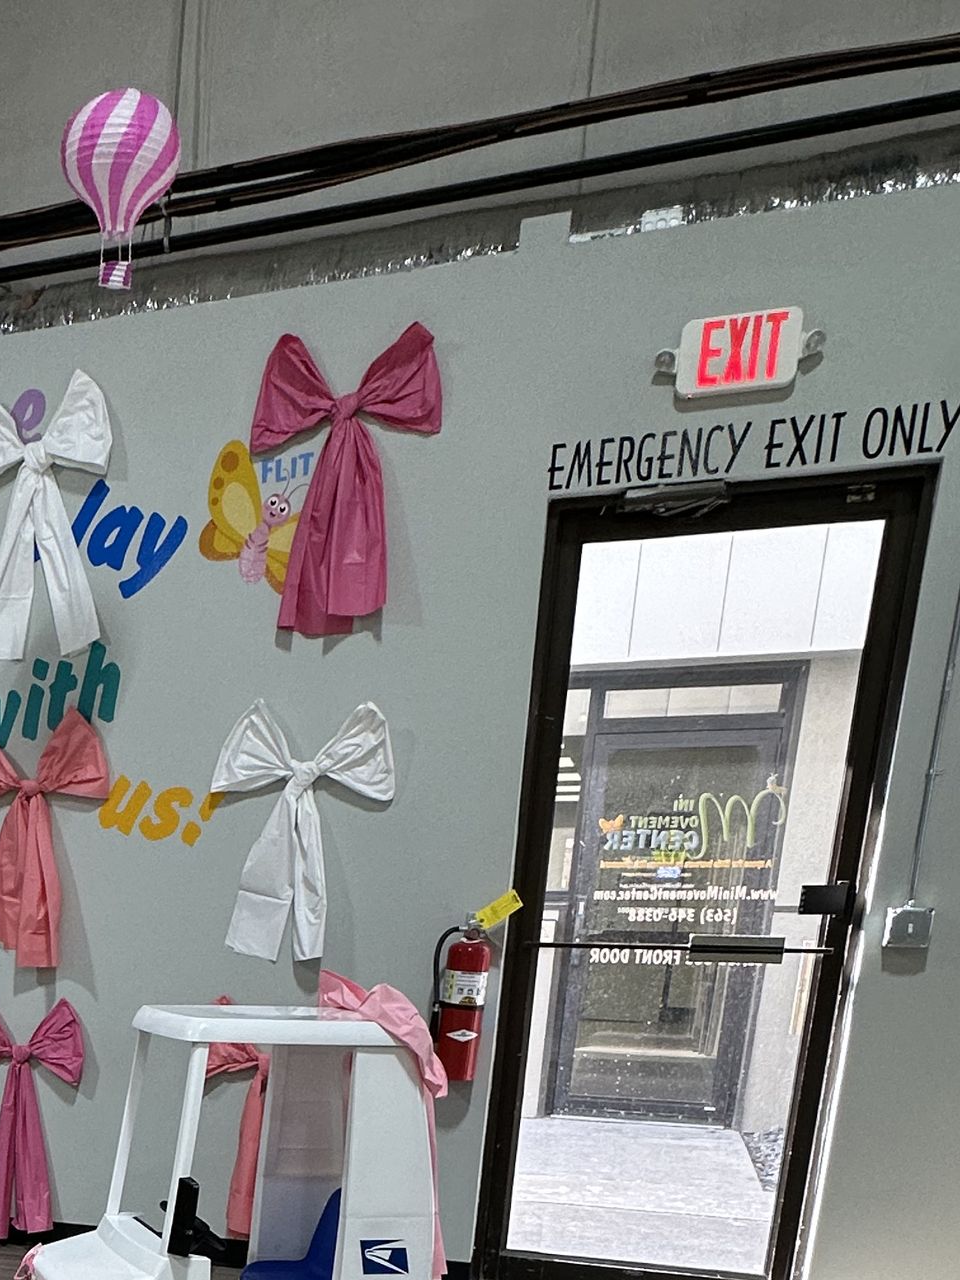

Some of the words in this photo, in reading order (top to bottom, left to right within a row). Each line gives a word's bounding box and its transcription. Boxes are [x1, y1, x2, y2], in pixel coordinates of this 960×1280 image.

[696, 311, 790, 389] EXIT
[260, 451, 315, 485] FLIT
[547, 420, 753, 491] EMERGENCY
[764, 411, 848, 470] EXIT
[861, 399, 960, 460] ONLY
[34, 479, 189, 600] lay
[97, 774, 227, 847] us!
